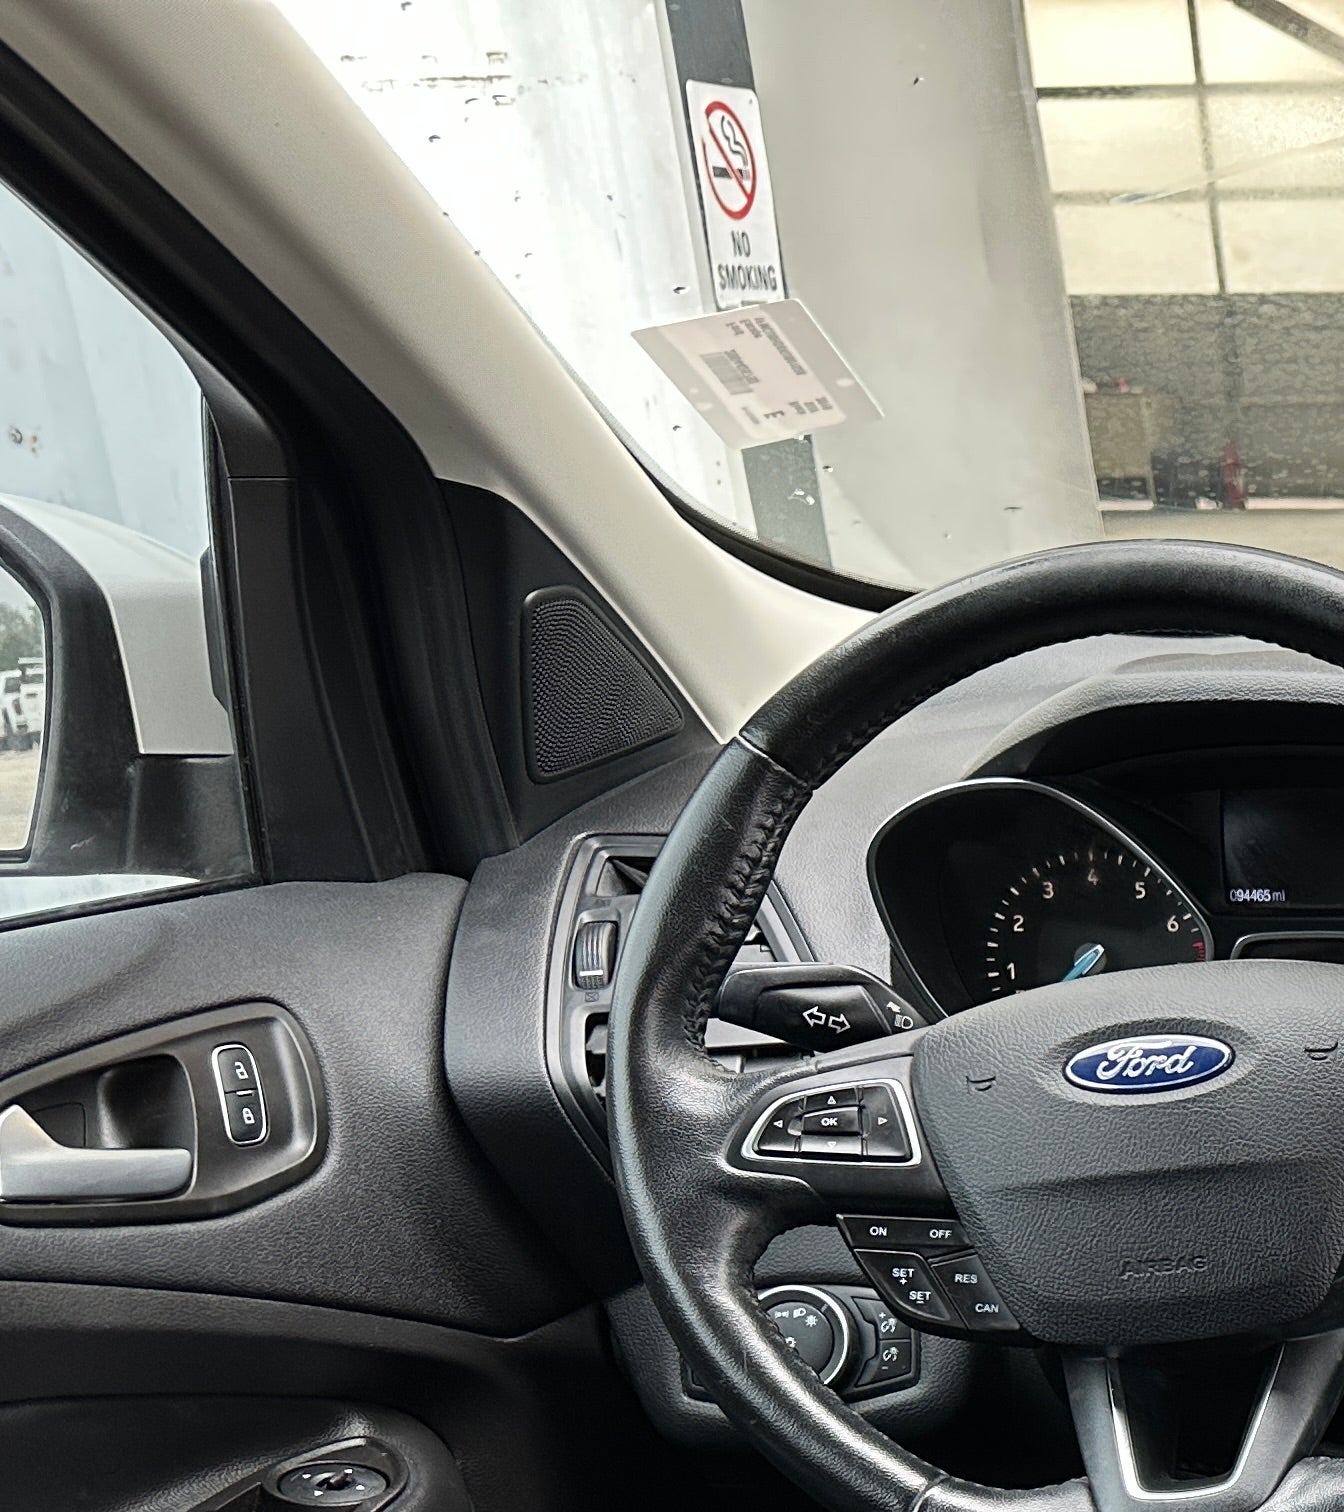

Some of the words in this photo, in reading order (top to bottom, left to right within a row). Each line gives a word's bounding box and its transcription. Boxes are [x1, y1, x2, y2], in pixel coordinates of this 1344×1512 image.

[731, 230, 751, 258] NO
[717, 263, 777, 292] SMOKING
[1088, 868, 1099, 886] 4
[1042, 881, 1054, 899] 3
[1135, 881, 1146, 899] 5
[1013, 914, 1025, 932] 2
[1166, 915, 1180, 933] 6
[1006, 962, 1016, 980] 1
[1095, 1040, 1197, 1081] Ford
[820, 1117, 838, 1127] OK
[869, 1226, 888, 1237] ON
[929, 1229, 953, 1239] OFF
[892, 1268, 915, 1278] SET
[954, 1273, 978, 1284] RES
[909, 1291, 932, 1301] SET
[975, 1303, 999, 1313] CAN
